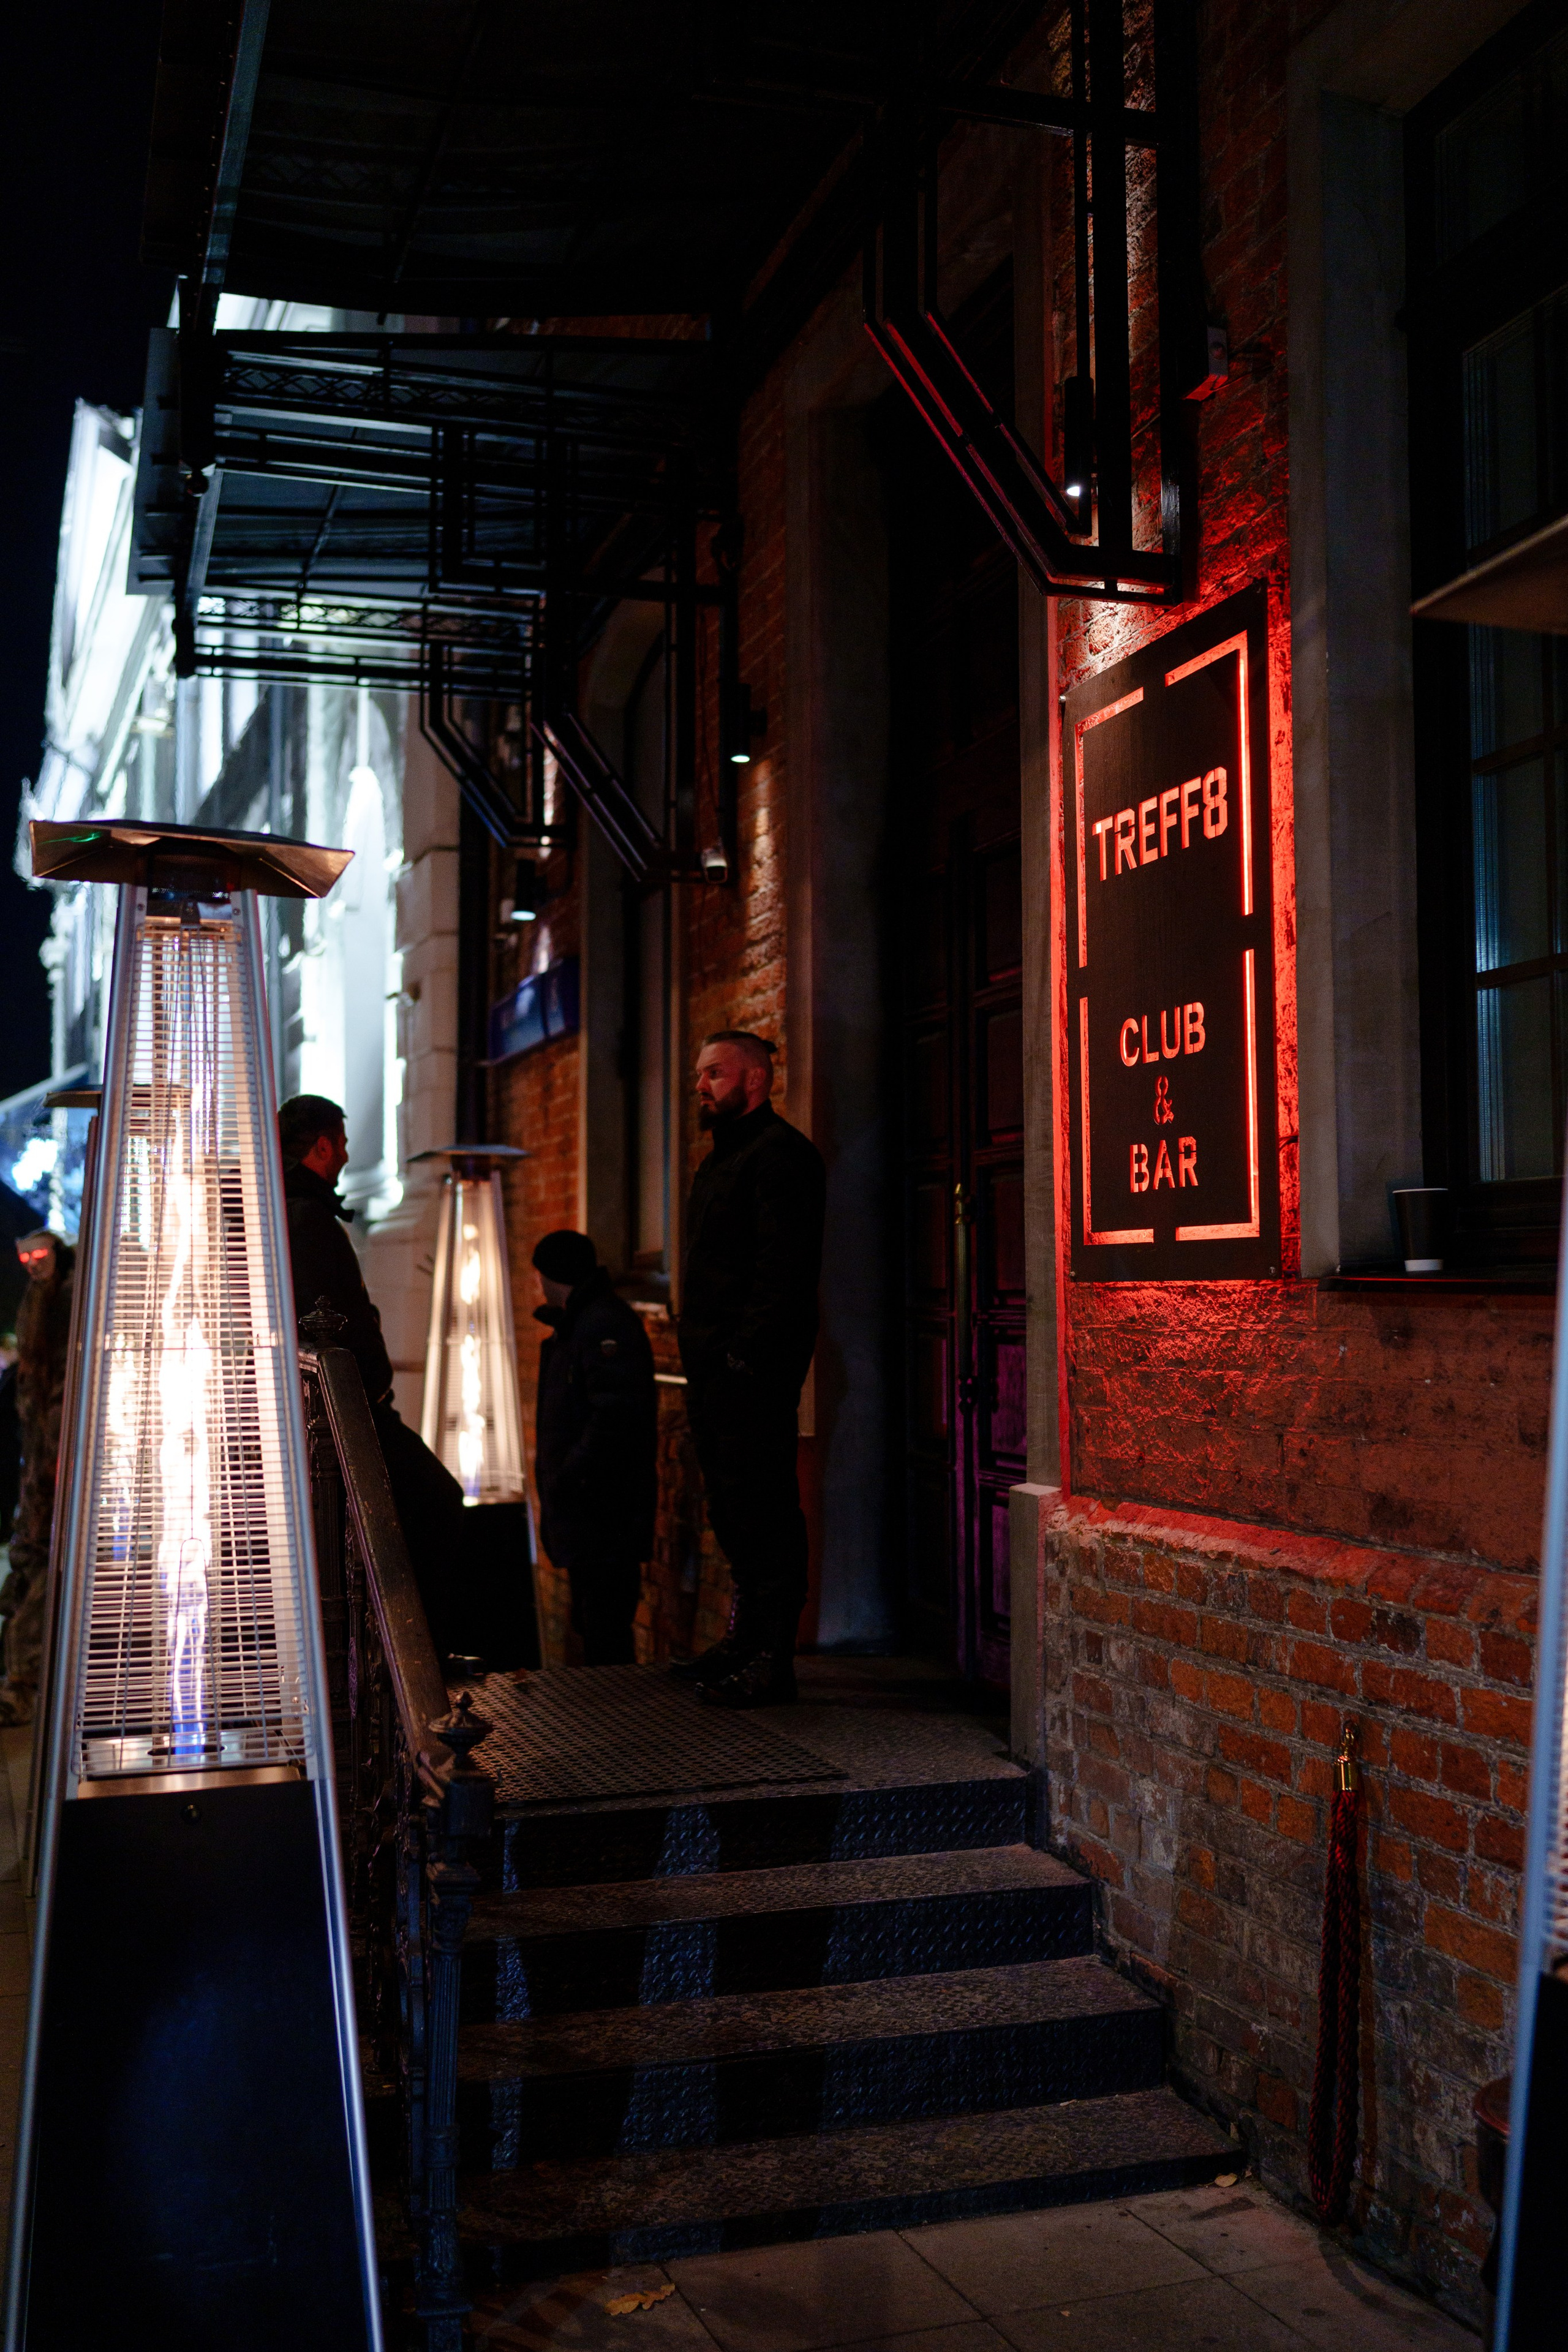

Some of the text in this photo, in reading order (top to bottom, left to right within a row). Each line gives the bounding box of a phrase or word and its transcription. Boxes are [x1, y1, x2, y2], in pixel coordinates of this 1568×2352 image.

[1092, 766, 1228, 881] TREFF8
[1120, 1001, 1206, 1067] CLUB
[1153, 1075, 1175, 1125] &
[1129, 1136, 1199, 1193] BAR
